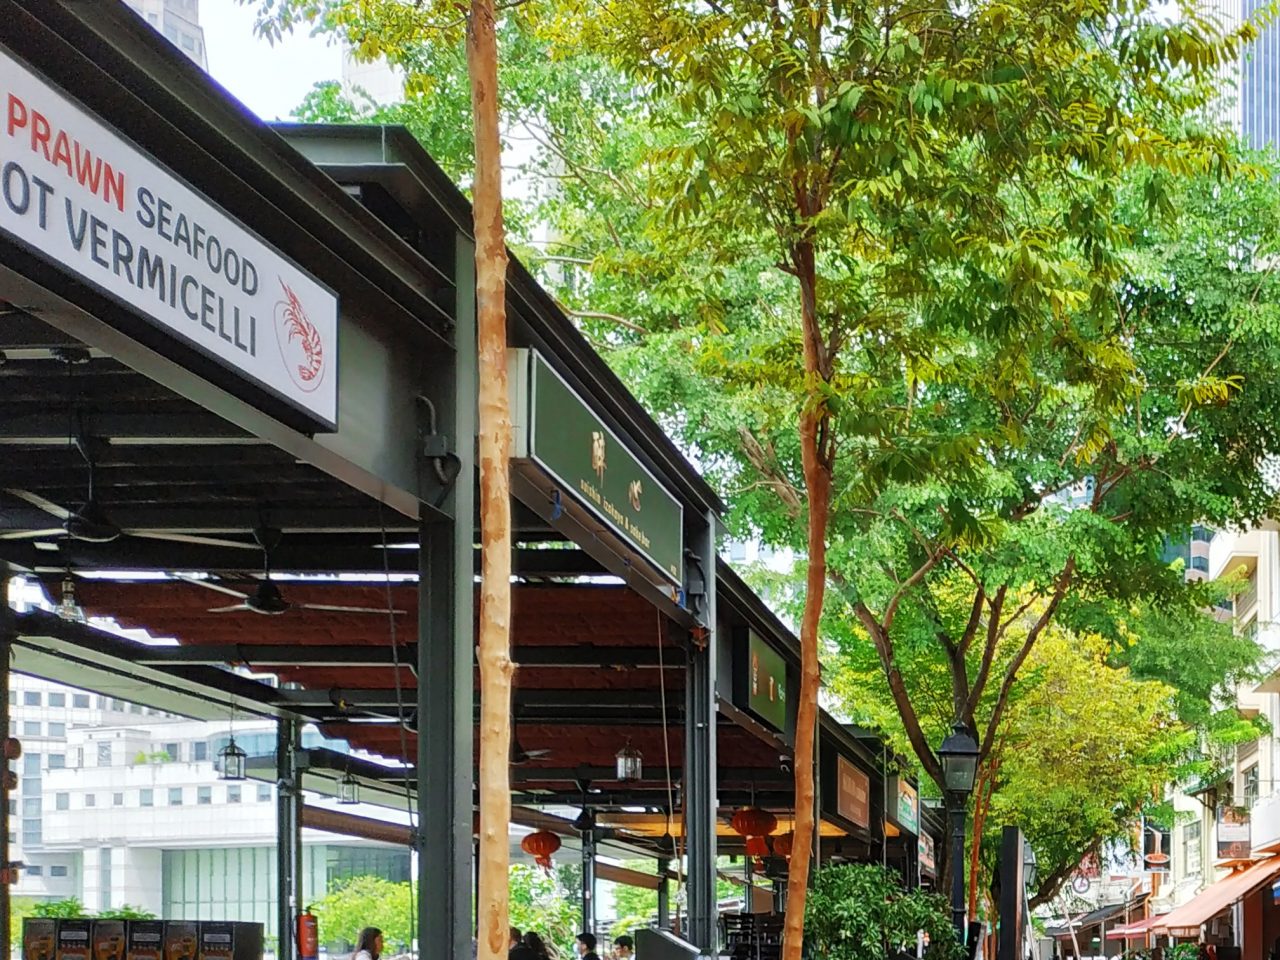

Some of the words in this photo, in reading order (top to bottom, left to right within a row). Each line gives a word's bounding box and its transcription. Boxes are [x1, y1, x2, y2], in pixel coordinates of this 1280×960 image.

[7, 92, 125, 213] PRAWN
[136, 186, 258, 297] SEAFOOD
[64, 196, 256, 358] VERMICELLI
